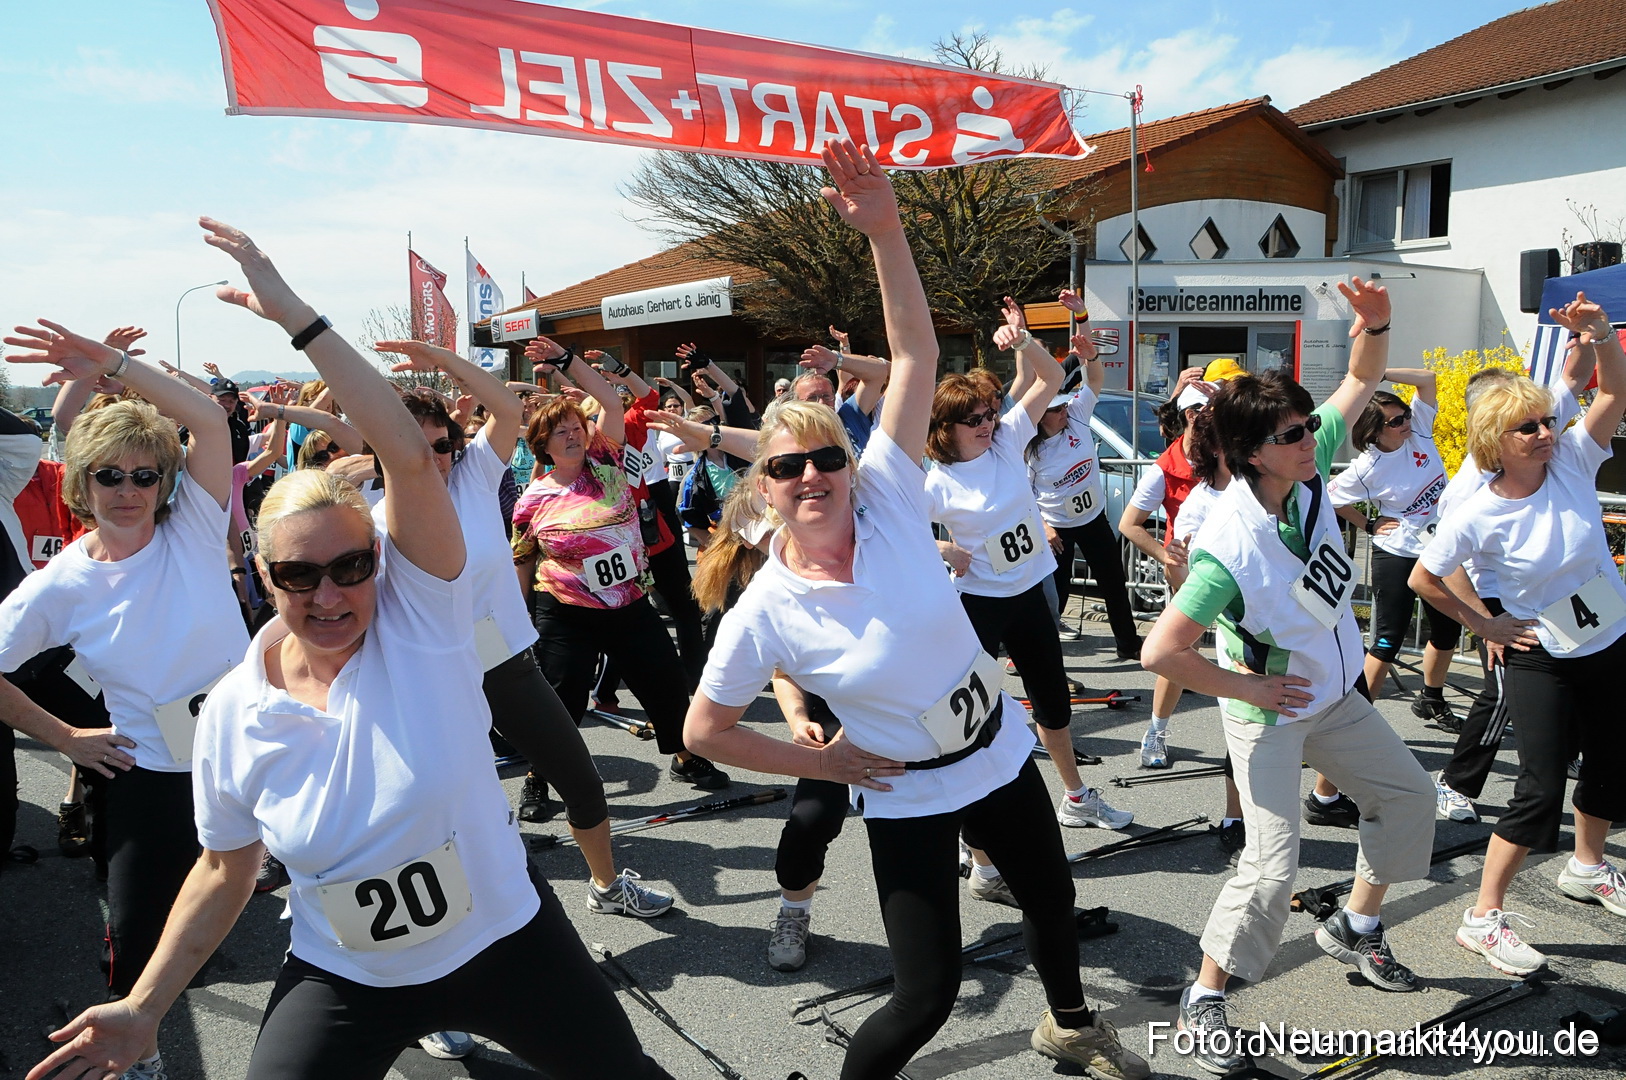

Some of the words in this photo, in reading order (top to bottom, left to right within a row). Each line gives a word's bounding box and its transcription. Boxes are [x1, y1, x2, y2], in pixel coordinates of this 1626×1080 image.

[421, 281, 436, 336] MOTORS
[608, 304, 645, 319] Autohaus
[647, 297, 681, 313] Gerhart
[684, 295, 692, 308] &
[695, 291, 721, 308] Jänig
[1130, 288, 1302, 312] Serviceannahme
[480, 284, 494, 368] SUKI
[504, 318, 531, 333] SEAT
[625, 450, 641, 479] 101
[672, 465, 683, 477] 118
[1072, 491, 1093, 514] 30
[41, 538, 62, 557] 46
[1000, 523, 1034, 562] 83
[594, 553, 627, 587] 86
[1302, 543, 1352, 609] 120
[1570, 593, 1600, 629] 4
[949, 670, 991, 741] 21
[355, 861, 448, 942] 20
